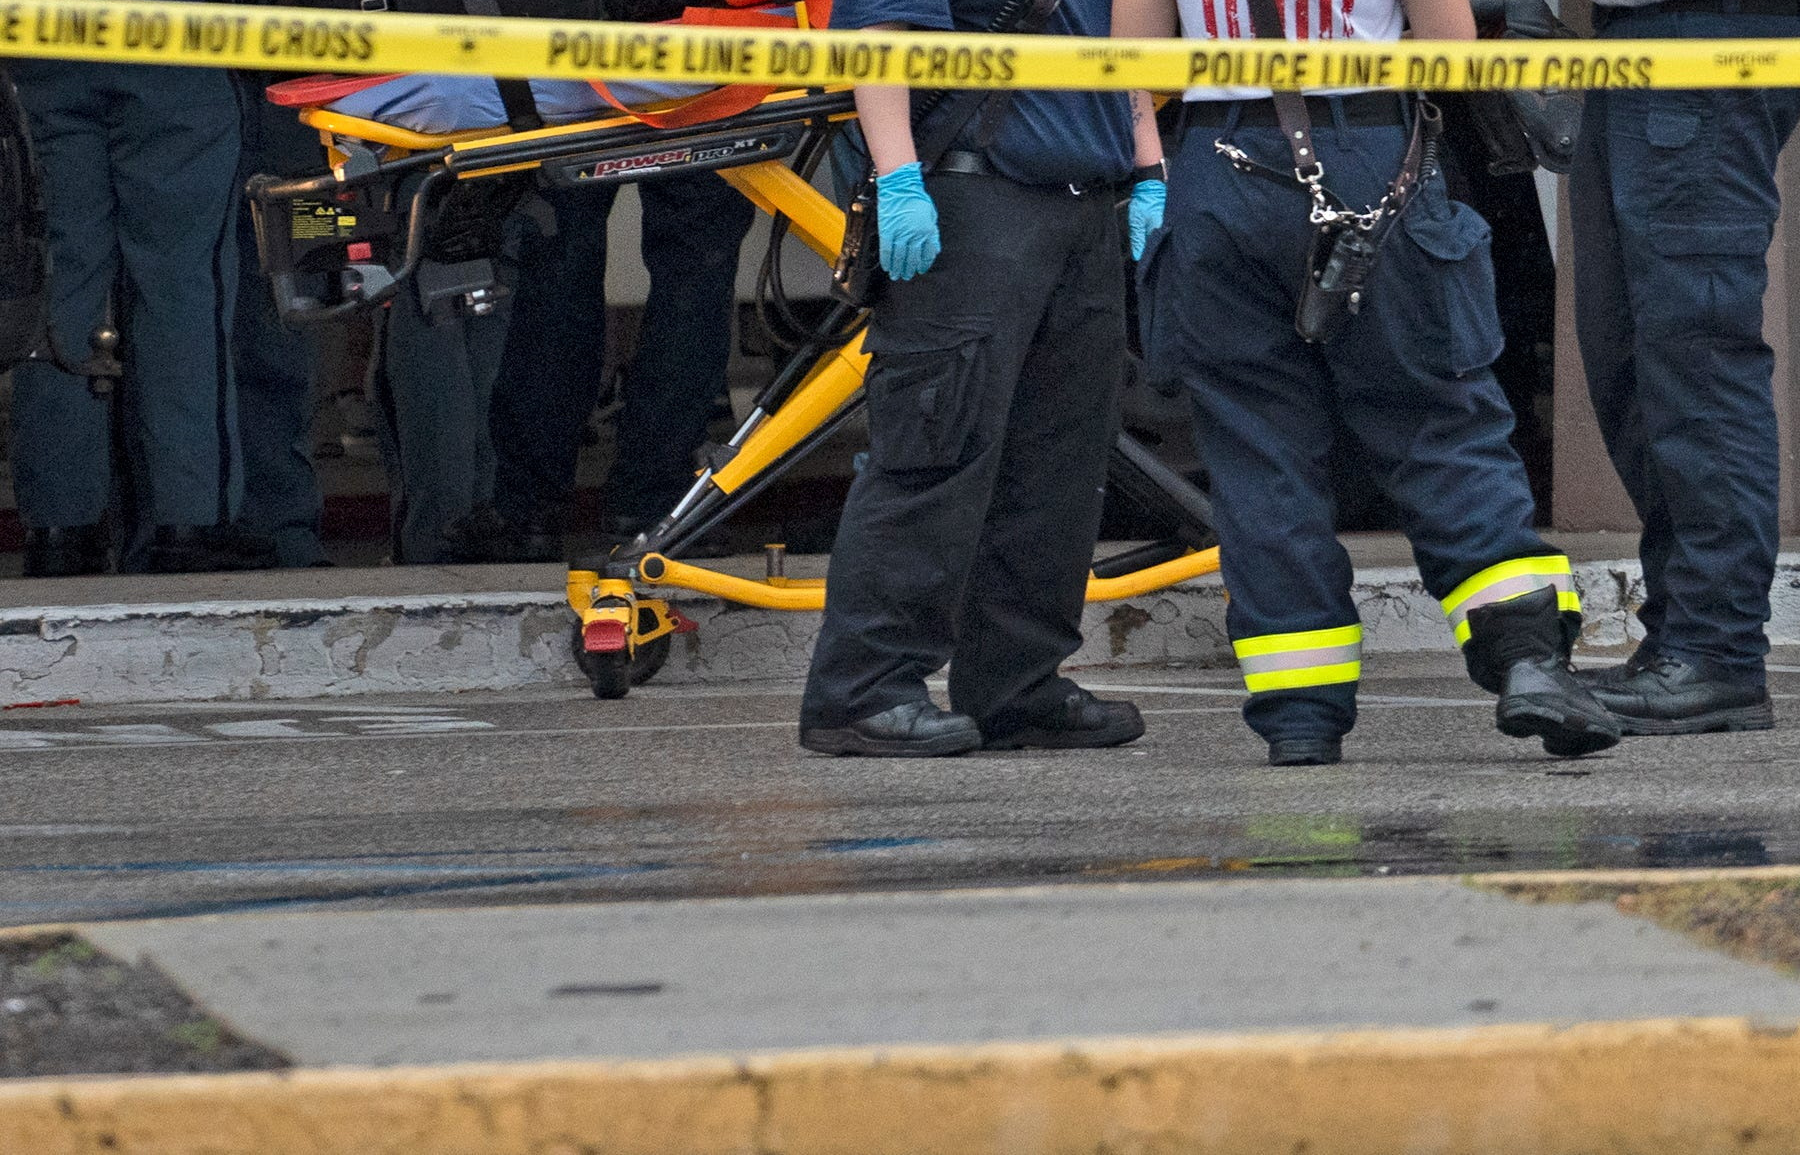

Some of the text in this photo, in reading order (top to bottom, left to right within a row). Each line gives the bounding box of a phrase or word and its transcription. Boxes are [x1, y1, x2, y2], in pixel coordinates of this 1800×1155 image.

[34, 7, 111, 48] LINE
[122, 11, 170, 51] DO
[181, 15, 248, 54] NOT
[260, 19, 375, 61] CROSS
[547, 31, 1017, 84] POLICE LINE DO NOT CROSS
[1188, 51, 1653, 89] POLICE LINE DO NOT CROSS
